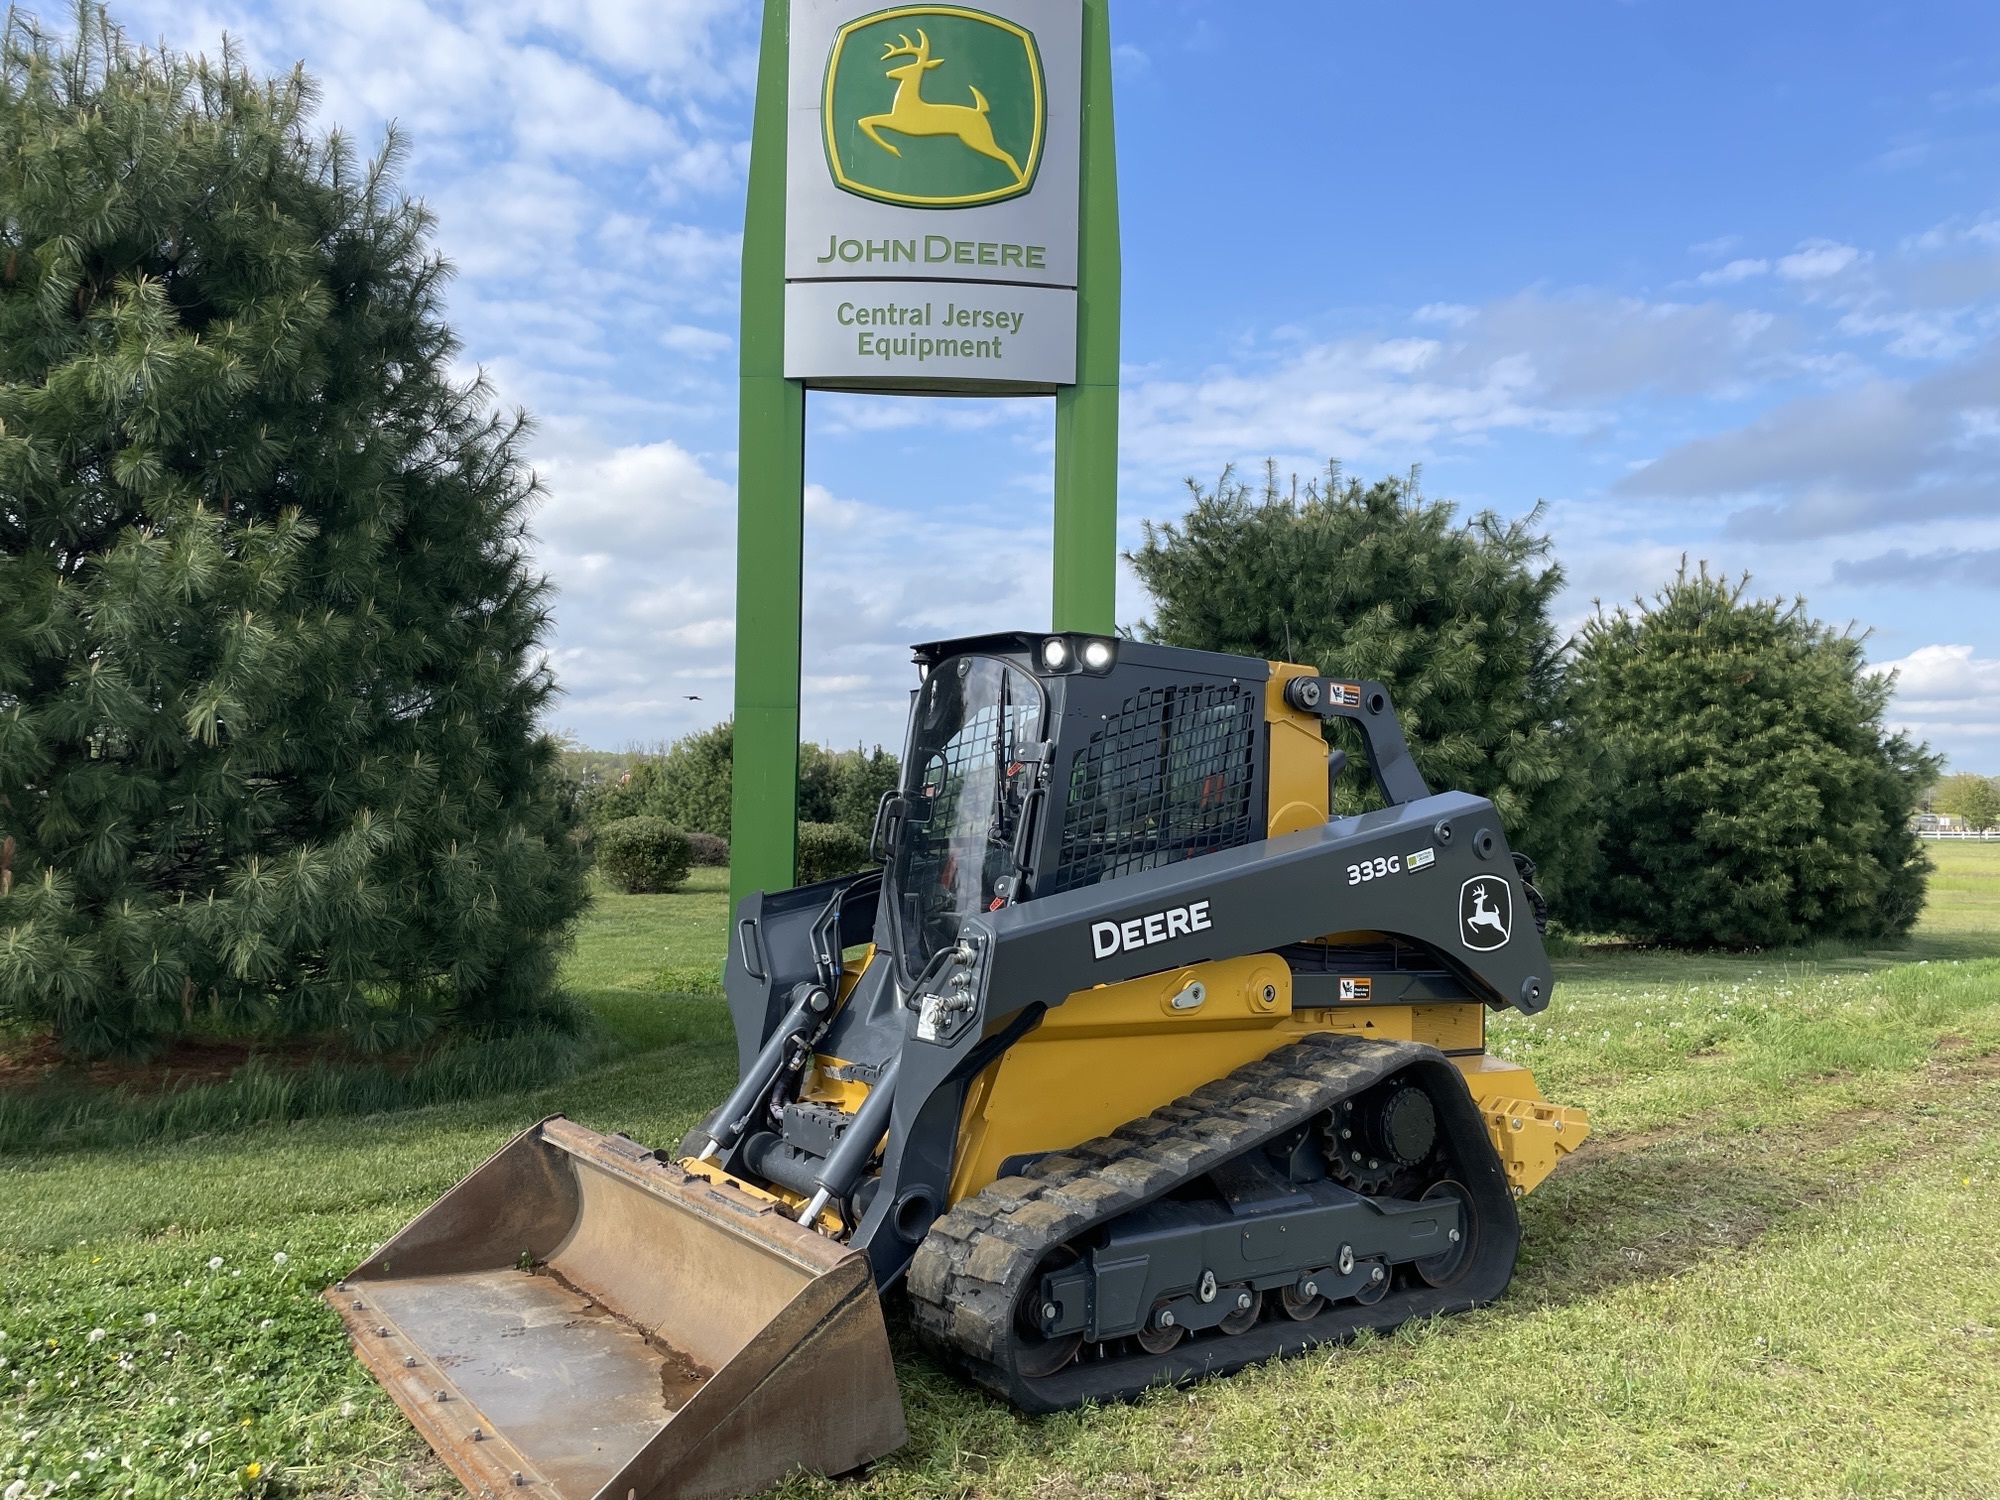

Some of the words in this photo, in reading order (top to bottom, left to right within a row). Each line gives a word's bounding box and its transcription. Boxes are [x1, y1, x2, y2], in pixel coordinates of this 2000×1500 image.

[817, 235, 916, 264] JOHN
[924, 235, 1047, 269] DEERE
[837, 302, 931, 326] Central
[942, 303, 1024, 335] Jersey
[858, 332, 1002, 361] Equipment
[1347, 855, 1400, 885] 333G
[1091, 900, 1212, 959] DEERE
